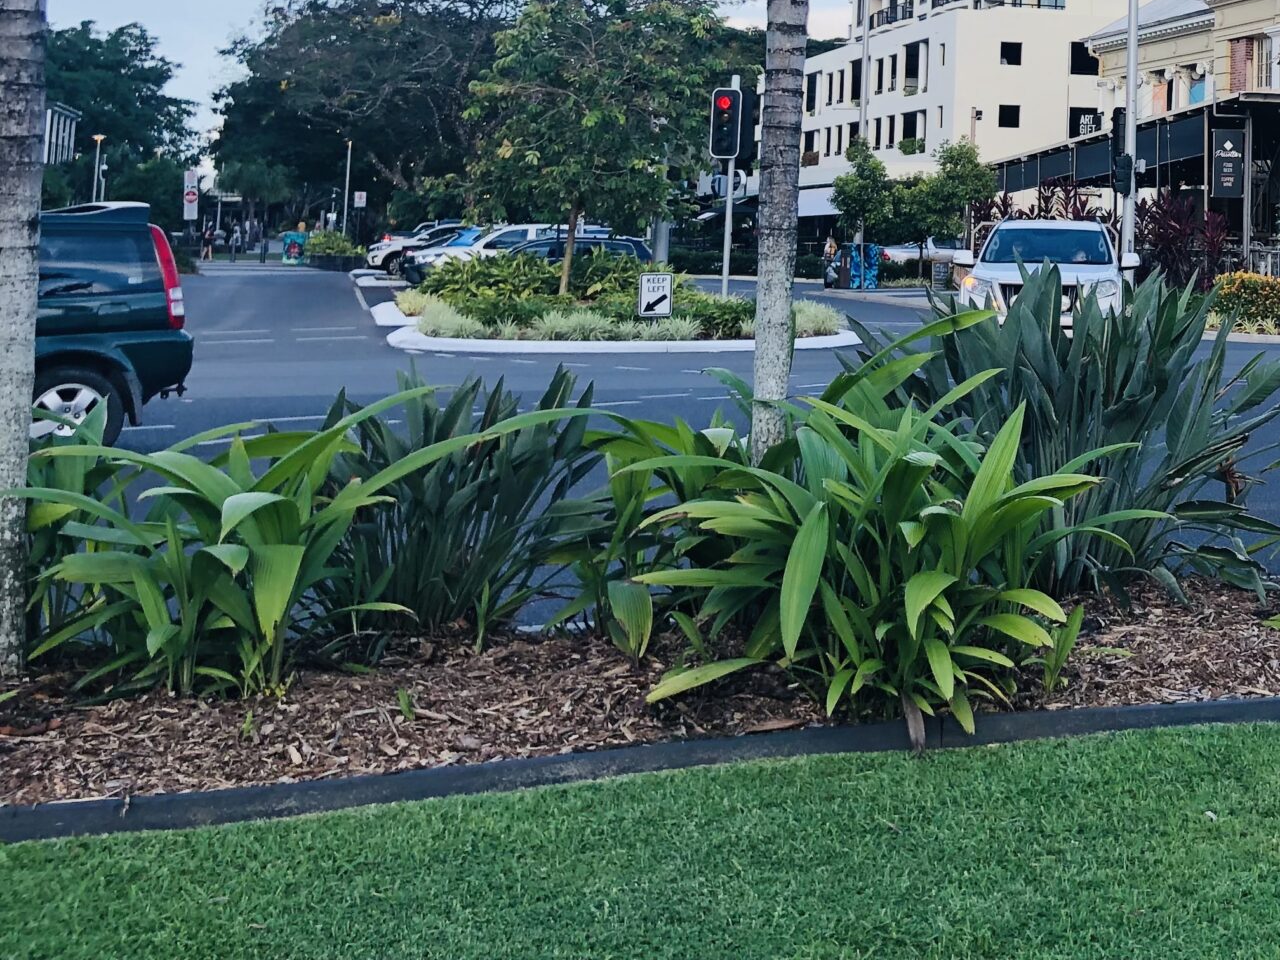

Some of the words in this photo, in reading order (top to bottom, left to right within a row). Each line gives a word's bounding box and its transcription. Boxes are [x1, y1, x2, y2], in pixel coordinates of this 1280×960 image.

[1080, 115, 1094, 124] ART
[1080, 125, 1096, 135] GIFT
[646, 276, 667, 284] KEEP
[647, 285, 666, 293] LEFT
